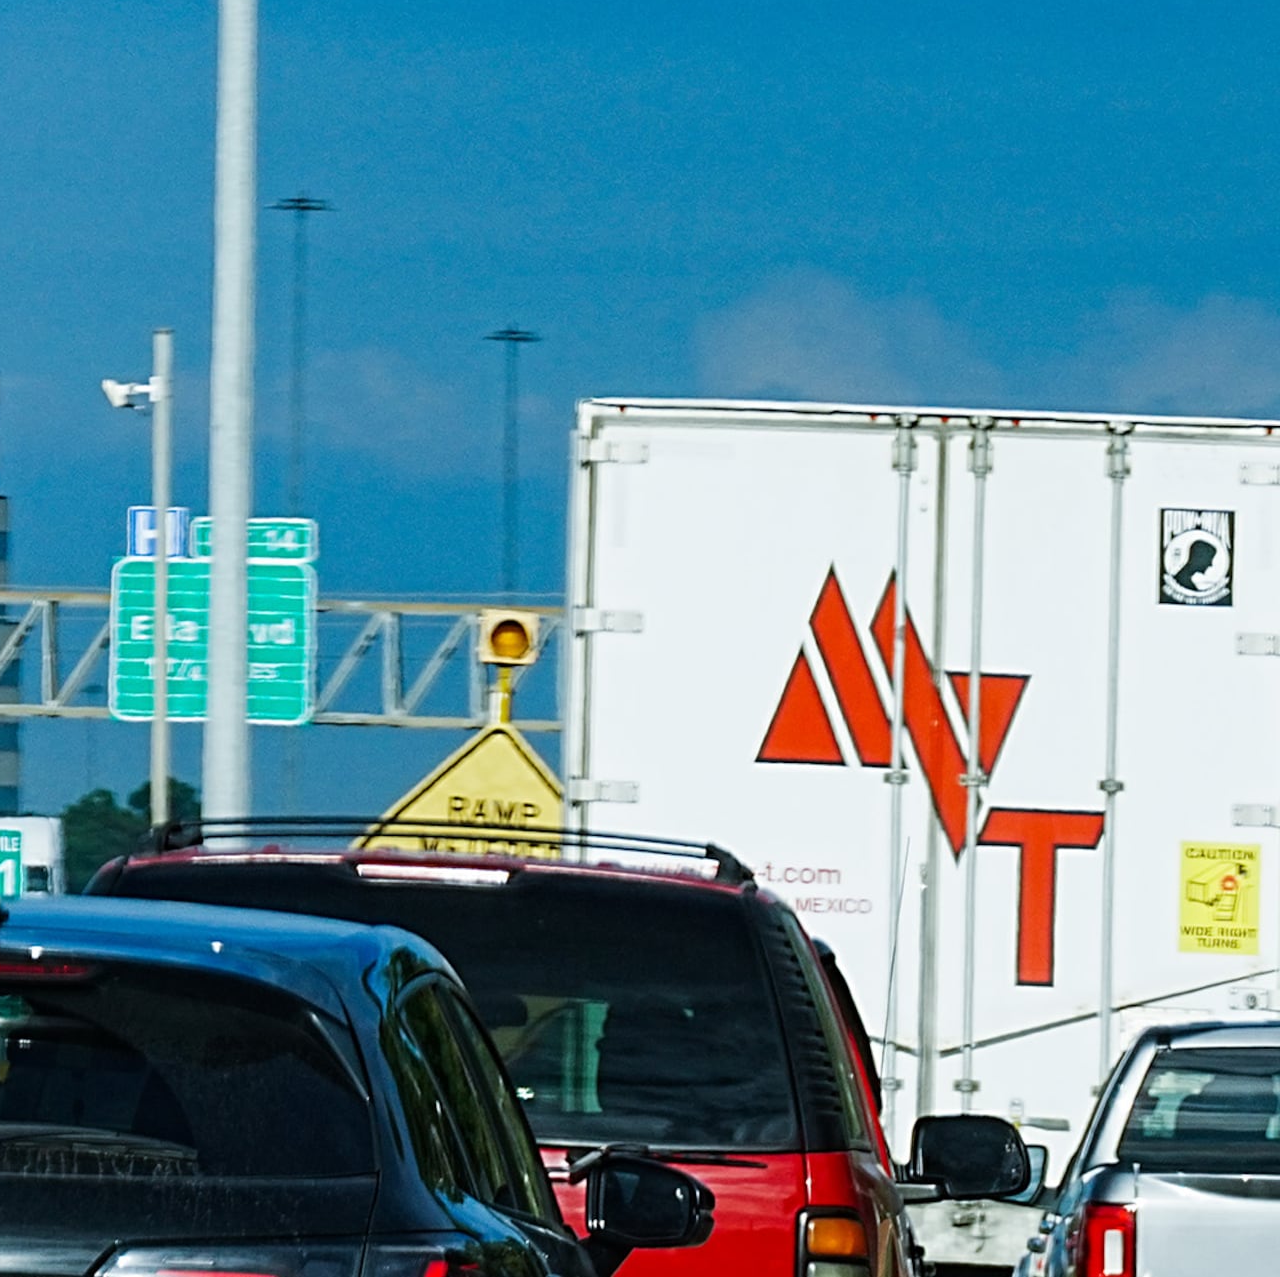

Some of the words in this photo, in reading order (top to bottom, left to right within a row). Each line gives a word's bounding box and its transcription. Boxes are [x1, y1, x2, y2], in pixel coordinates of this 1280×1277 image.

[130, 614, 200, 642] Ela
[447, 794, 542, 828] RAMP
[1185, 847, 1256, 860] CAUTION
[795, 897, 873, 914] MEXICO
[1180, 925, 1214, 937] WIDE
[1196, 937, 1242, 949] TURNS
